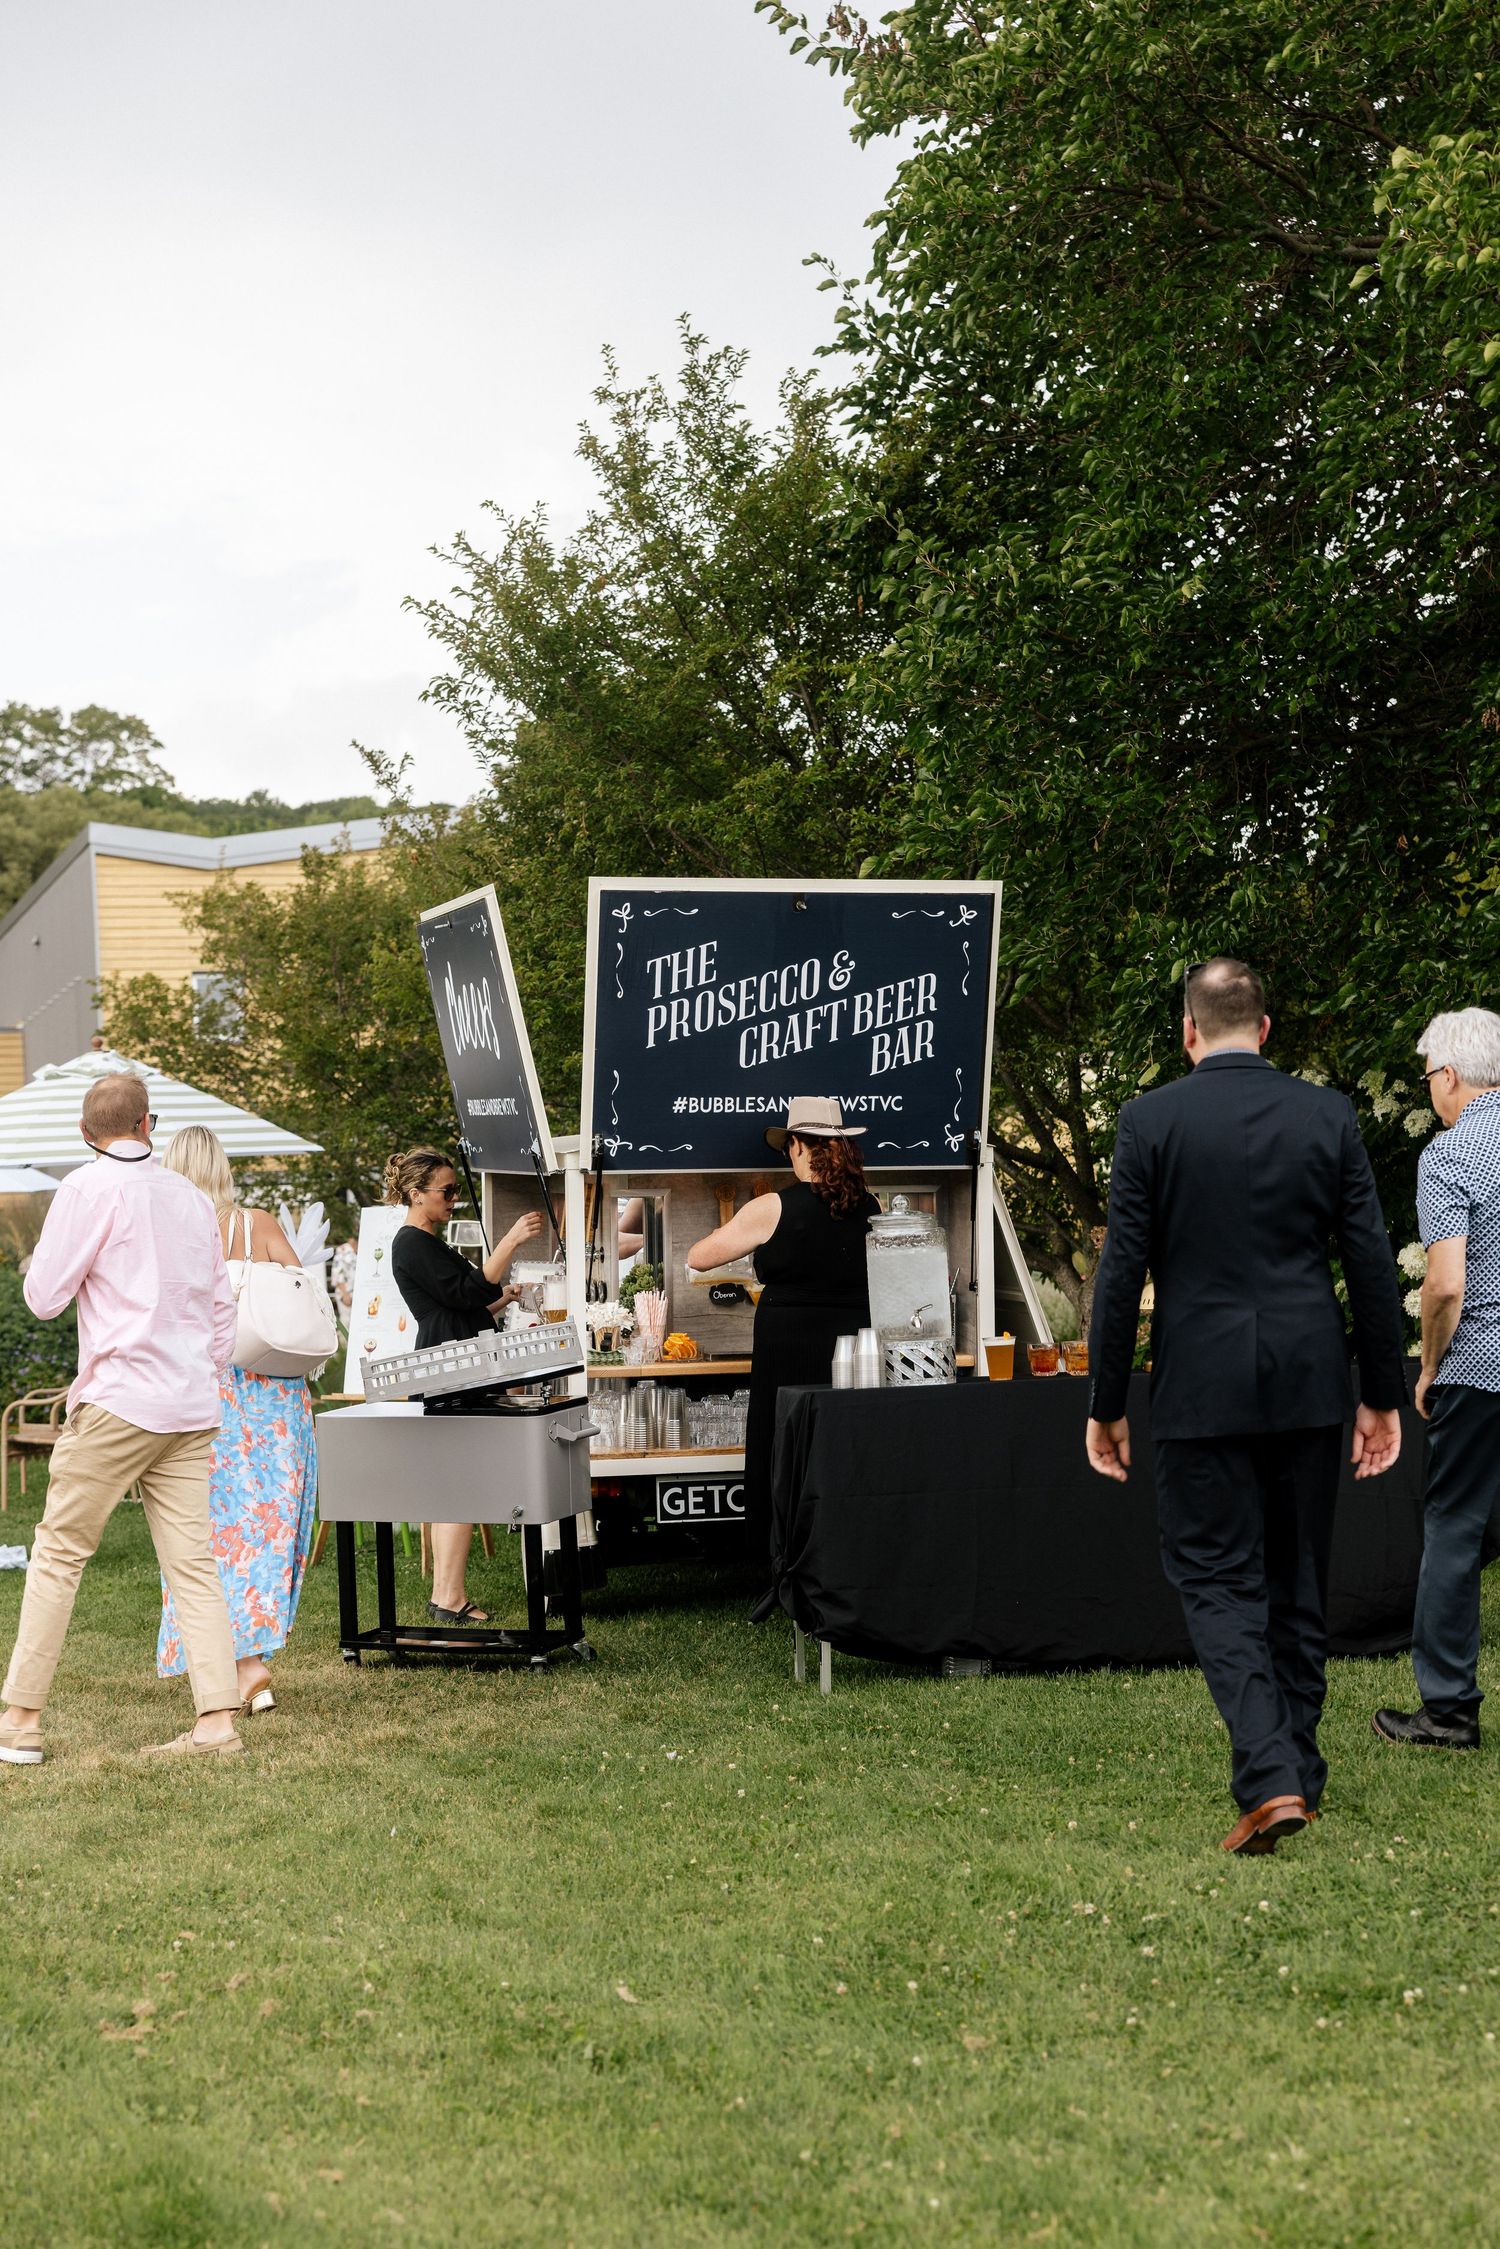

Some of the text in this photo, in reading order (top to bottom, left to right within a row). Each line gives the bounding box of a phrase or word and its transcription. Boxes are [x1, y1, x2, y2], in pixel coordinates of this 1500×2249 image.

[645, 950, 856, 1049] PROSECCO &
[646, 940, 718, 1000] THE
[739, 972, 938, 1069] CRAFT BEER
[869, 1020, 936, 1077] BAR
[672, 1095, 904, 1114] #BUBBLESANWSTVC
